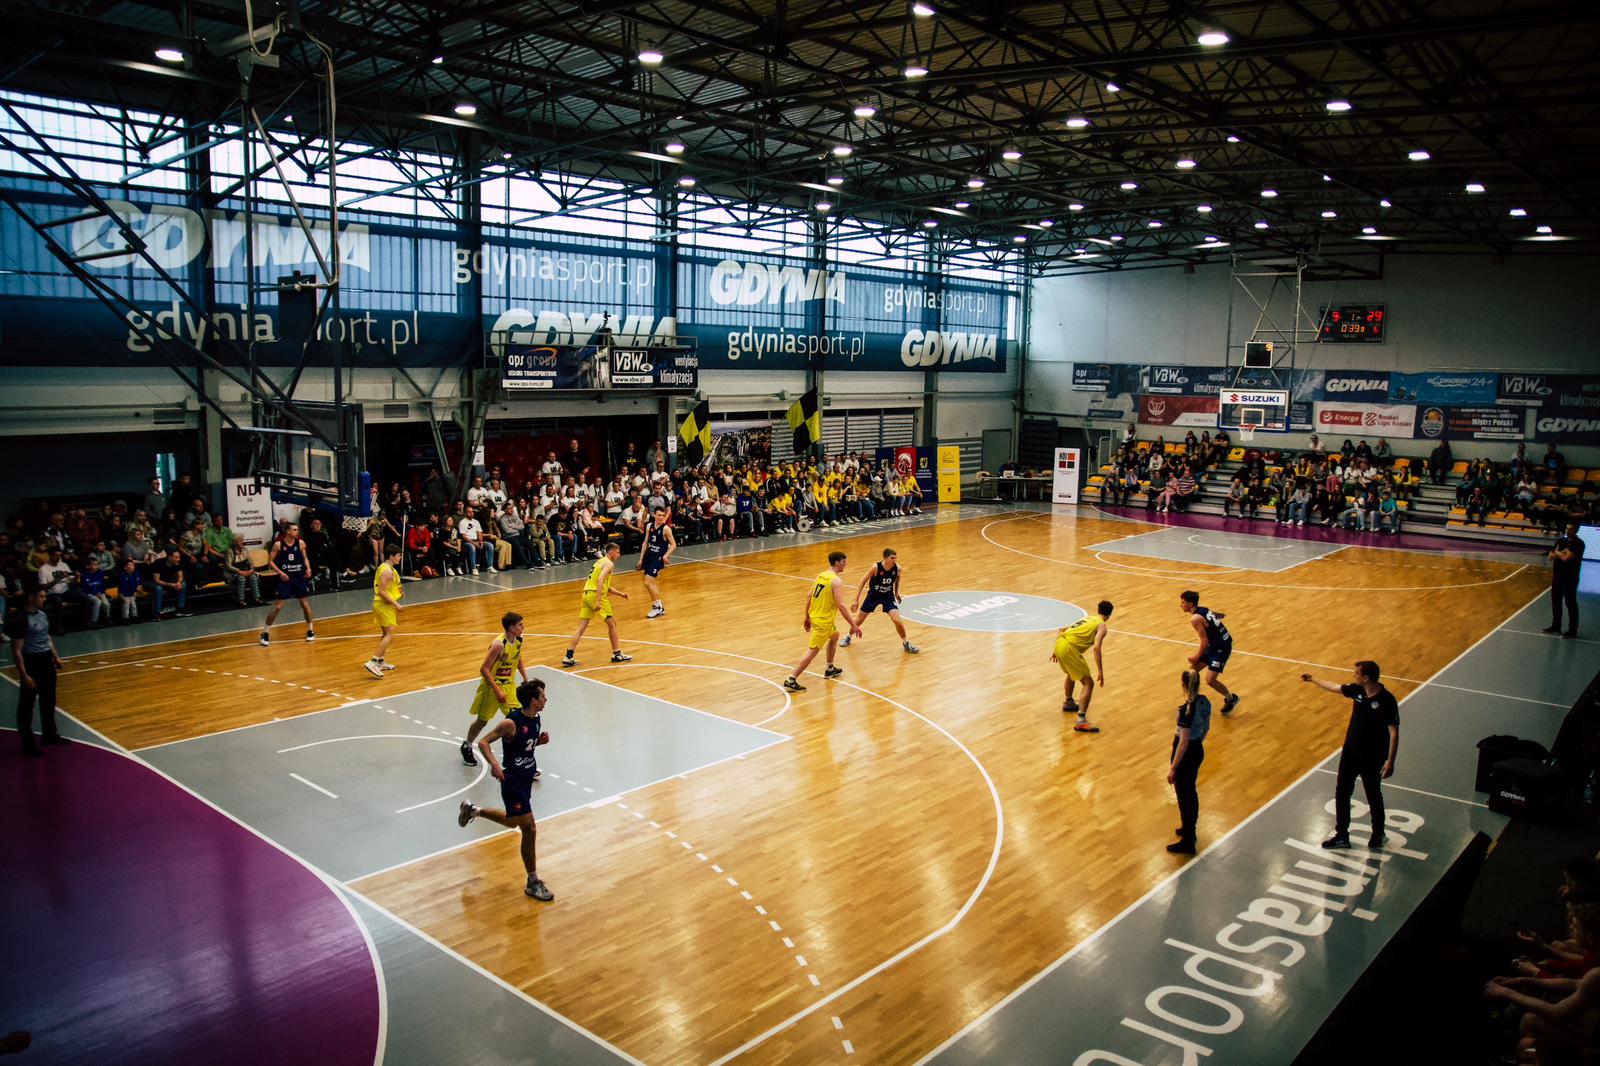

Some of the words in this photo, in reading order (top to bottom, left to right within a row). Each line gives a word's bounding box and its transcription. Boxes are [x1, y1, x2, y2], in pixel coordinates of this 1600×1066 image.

[71, 199, 370, 273] GDYNIA
[453, 242, 656, 295] gdyniasport.pl
[709, 259, 846, 305] GDYNIA
[884, 283, 989, 314] gdyniasport.pl
[125, 301, 419, 354] gdyniaort.pl
[490, 308, 677, 355] GDYNIA
[727, 326, 866, 361] gdyniasport.pl
[900, 329, 997, 367] GDYNIA
[616, 352, 644, 371] VBW
[1155, 369, 1179, 382] VBW
[1325, 378, 1389, 392] GDYNIA
[1504, 377, 1540, 393] VBW
[1241, 395, 1279, 403] SUZUKI
[1334, 414, 1359, 422] Energa
[1537, 417, 1600, 432] GDYN
[288, 553, 294, 561] 8
[813, 583, 825, 598] 17
